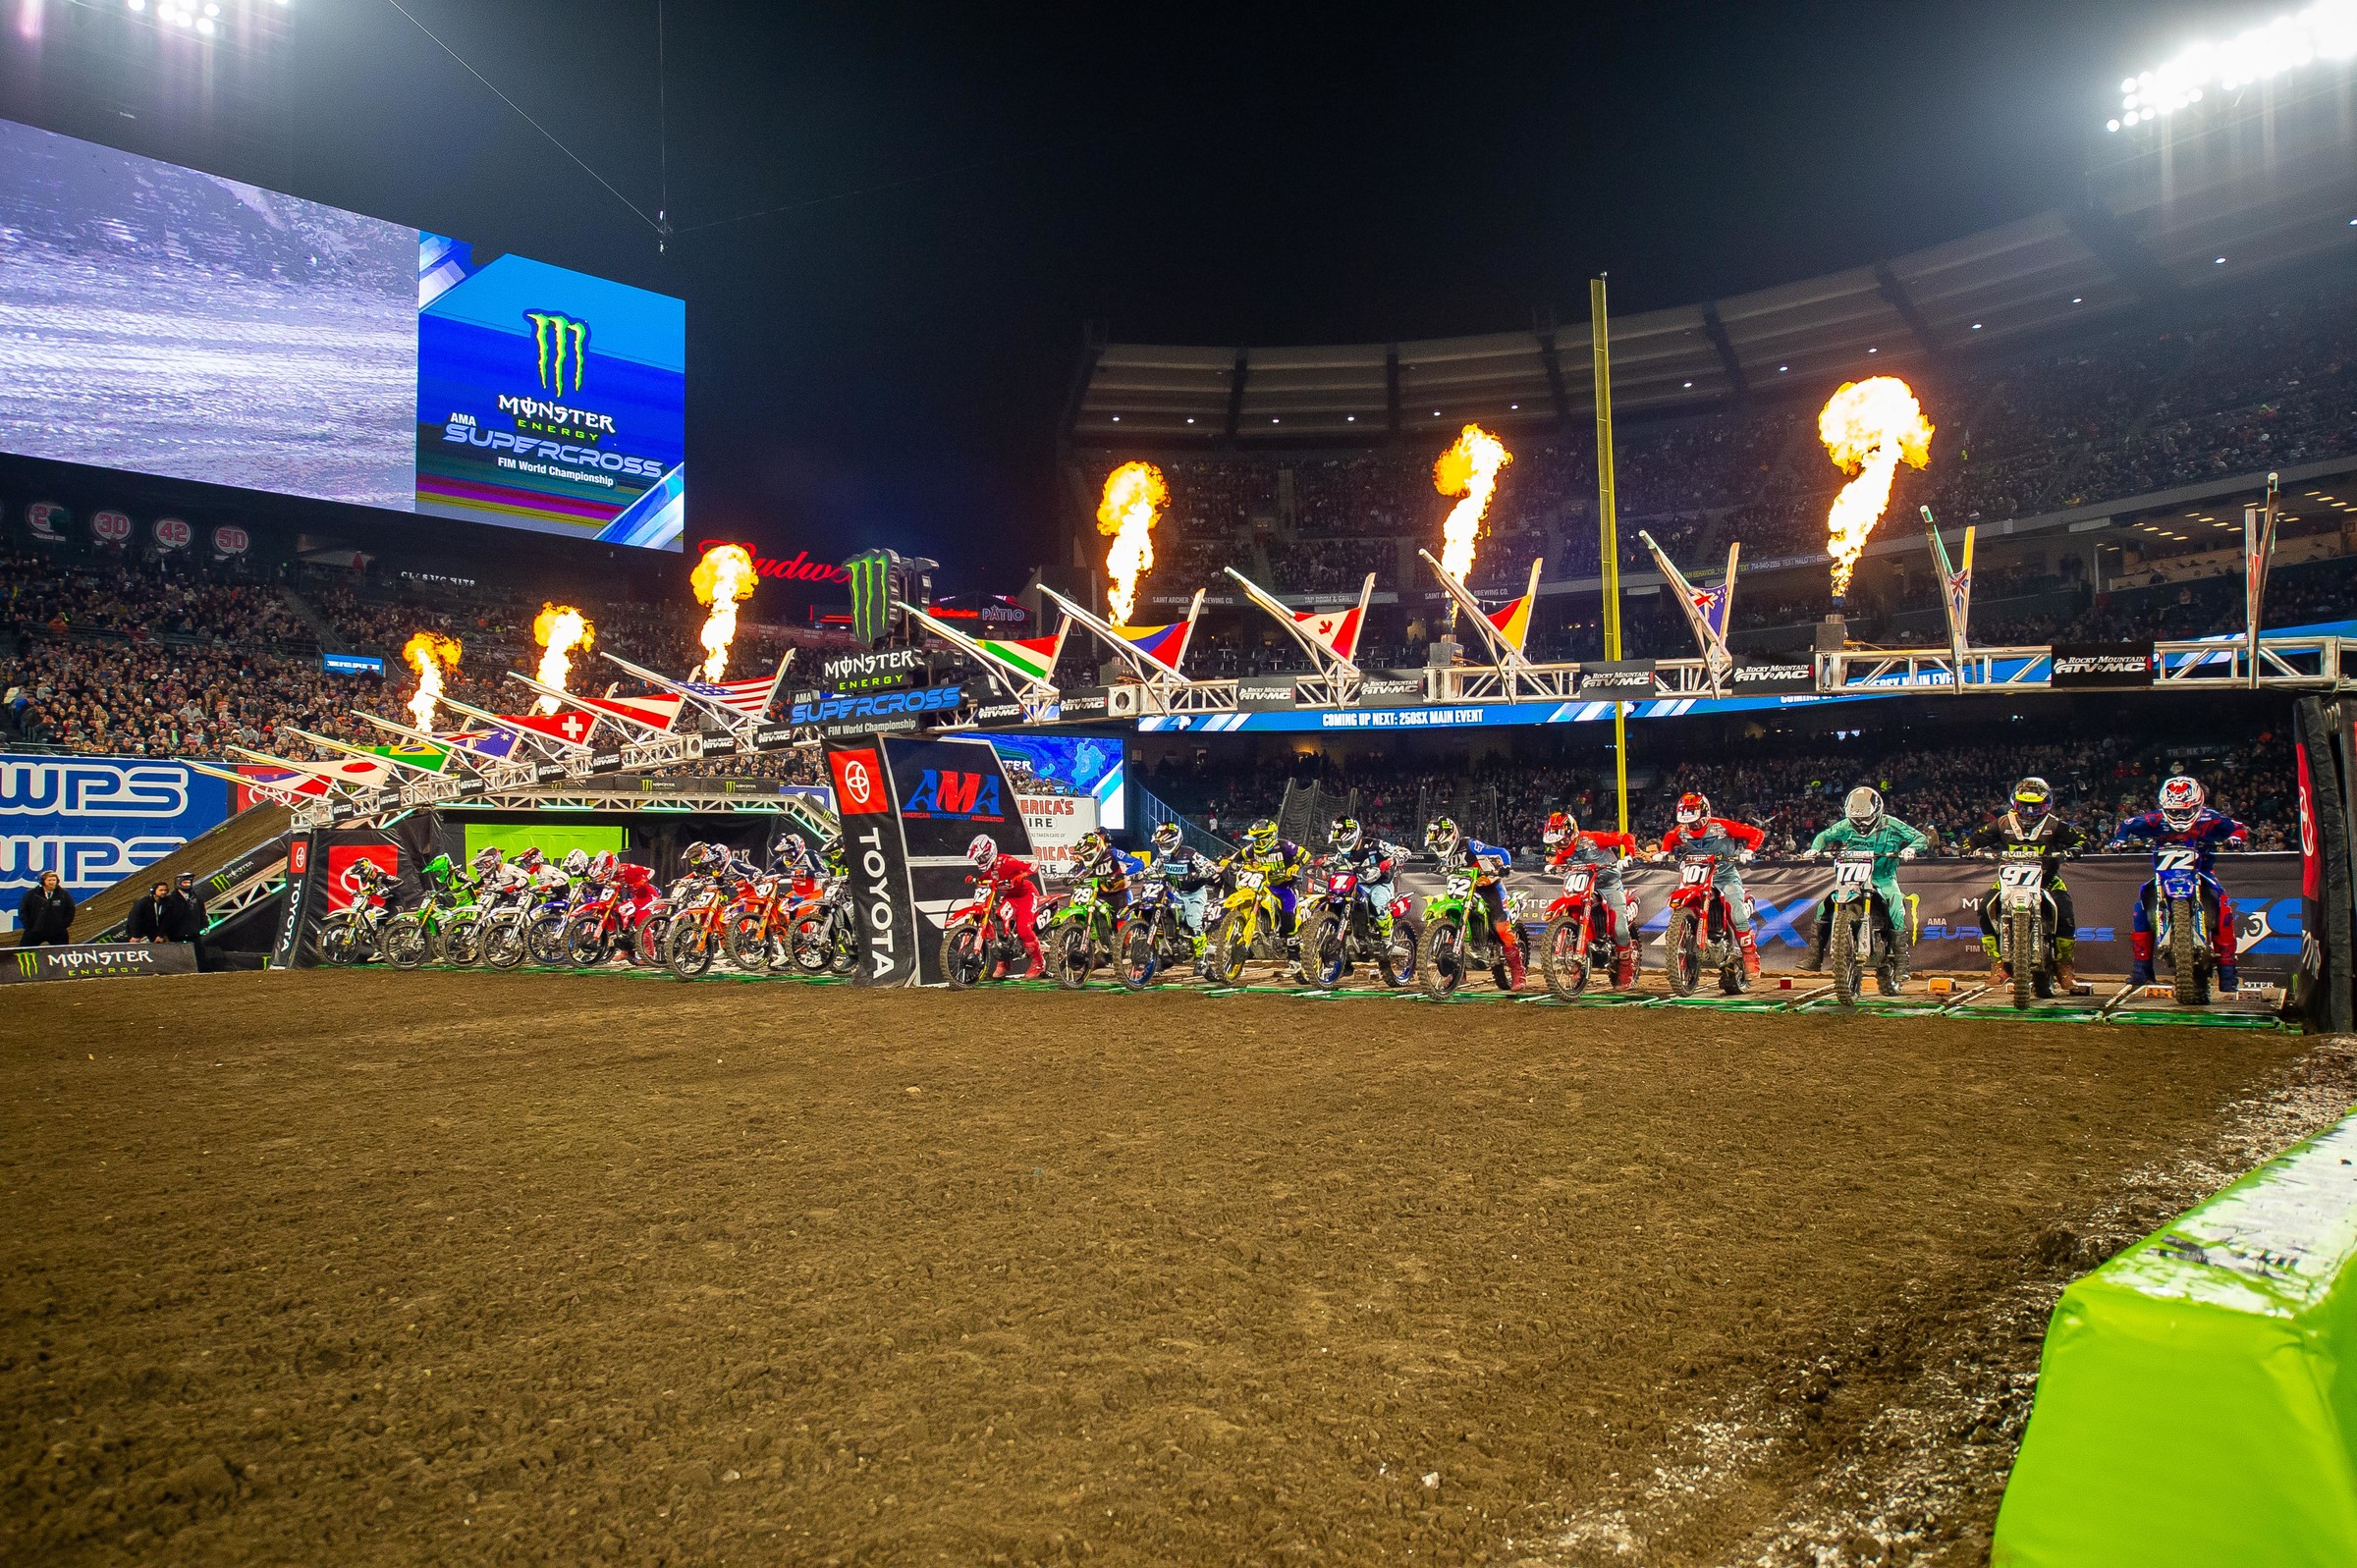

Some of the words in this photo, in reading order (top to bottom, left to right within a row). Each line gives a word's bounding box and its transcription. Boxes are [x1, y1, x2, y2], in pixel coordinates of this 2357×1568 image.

[450, 412, 476, 426] AMA
[498, 394, 616, 434] MONSTER
[518, 419, 599, 441] ENERGY
[442, 425, 663, 479] SUPERCROSS
[498, 457, 517, 469] FIM
[519, 460, 547, 474] World
[548, 465, 614, 487] Championship
[96, 514, 128, 535] 30
[158, 522, 188, 542] 42
[218, 530, 246, 549] 50
[982, 605, 1025, 621] PATIO
[824, 649, 915, 678] MONSTER
[839, 674, 904, 690] ENERGY
[790, 686, 964, 725] SUPERCROSS
[795, 692, 812, 704] AMA
[828, 726, 841, 735] FIM
[842, 724, 863, 734] World
[864, 719, 916, 733] Championship
[1322, 712, 1357, 727] COMING
[1358, 712, 1371, 726] UP
[1372, 711, 1398, 726] NEXT:
[1399, 710, 1429, 725] 250SX
[1429, 710, 1454, 724] MAIN
[1454, 708, 1484, 723] EVENT
[902, 769, 1005, 815] AMA
[1019, 799, 1074, 815] ERICA'S
[2157, 850, 2199, 871] 72
[1239, 871, 1264, 888] 26
[1682, 865, 1709, 883] 101
[1837, 863, 1871, 882] 170
[2002, 867, 2040, 886] 97
[1142, 883, 1164, 898] 32
[1447, 879, 1471, 895] 52
[1565, 874, 1589, 892] 40
[857, 828, 896, 979] TOYOTA
[973, 887, 991, 902] 62
[1074, 888, 1092, 903] 29
[281, 880, 302, 952] TOYOTA
[1036, 908, 1052, 930] 62
[48, 949, 153, 967] MONSTER
[69, 966, 139, 977] ENERGY
